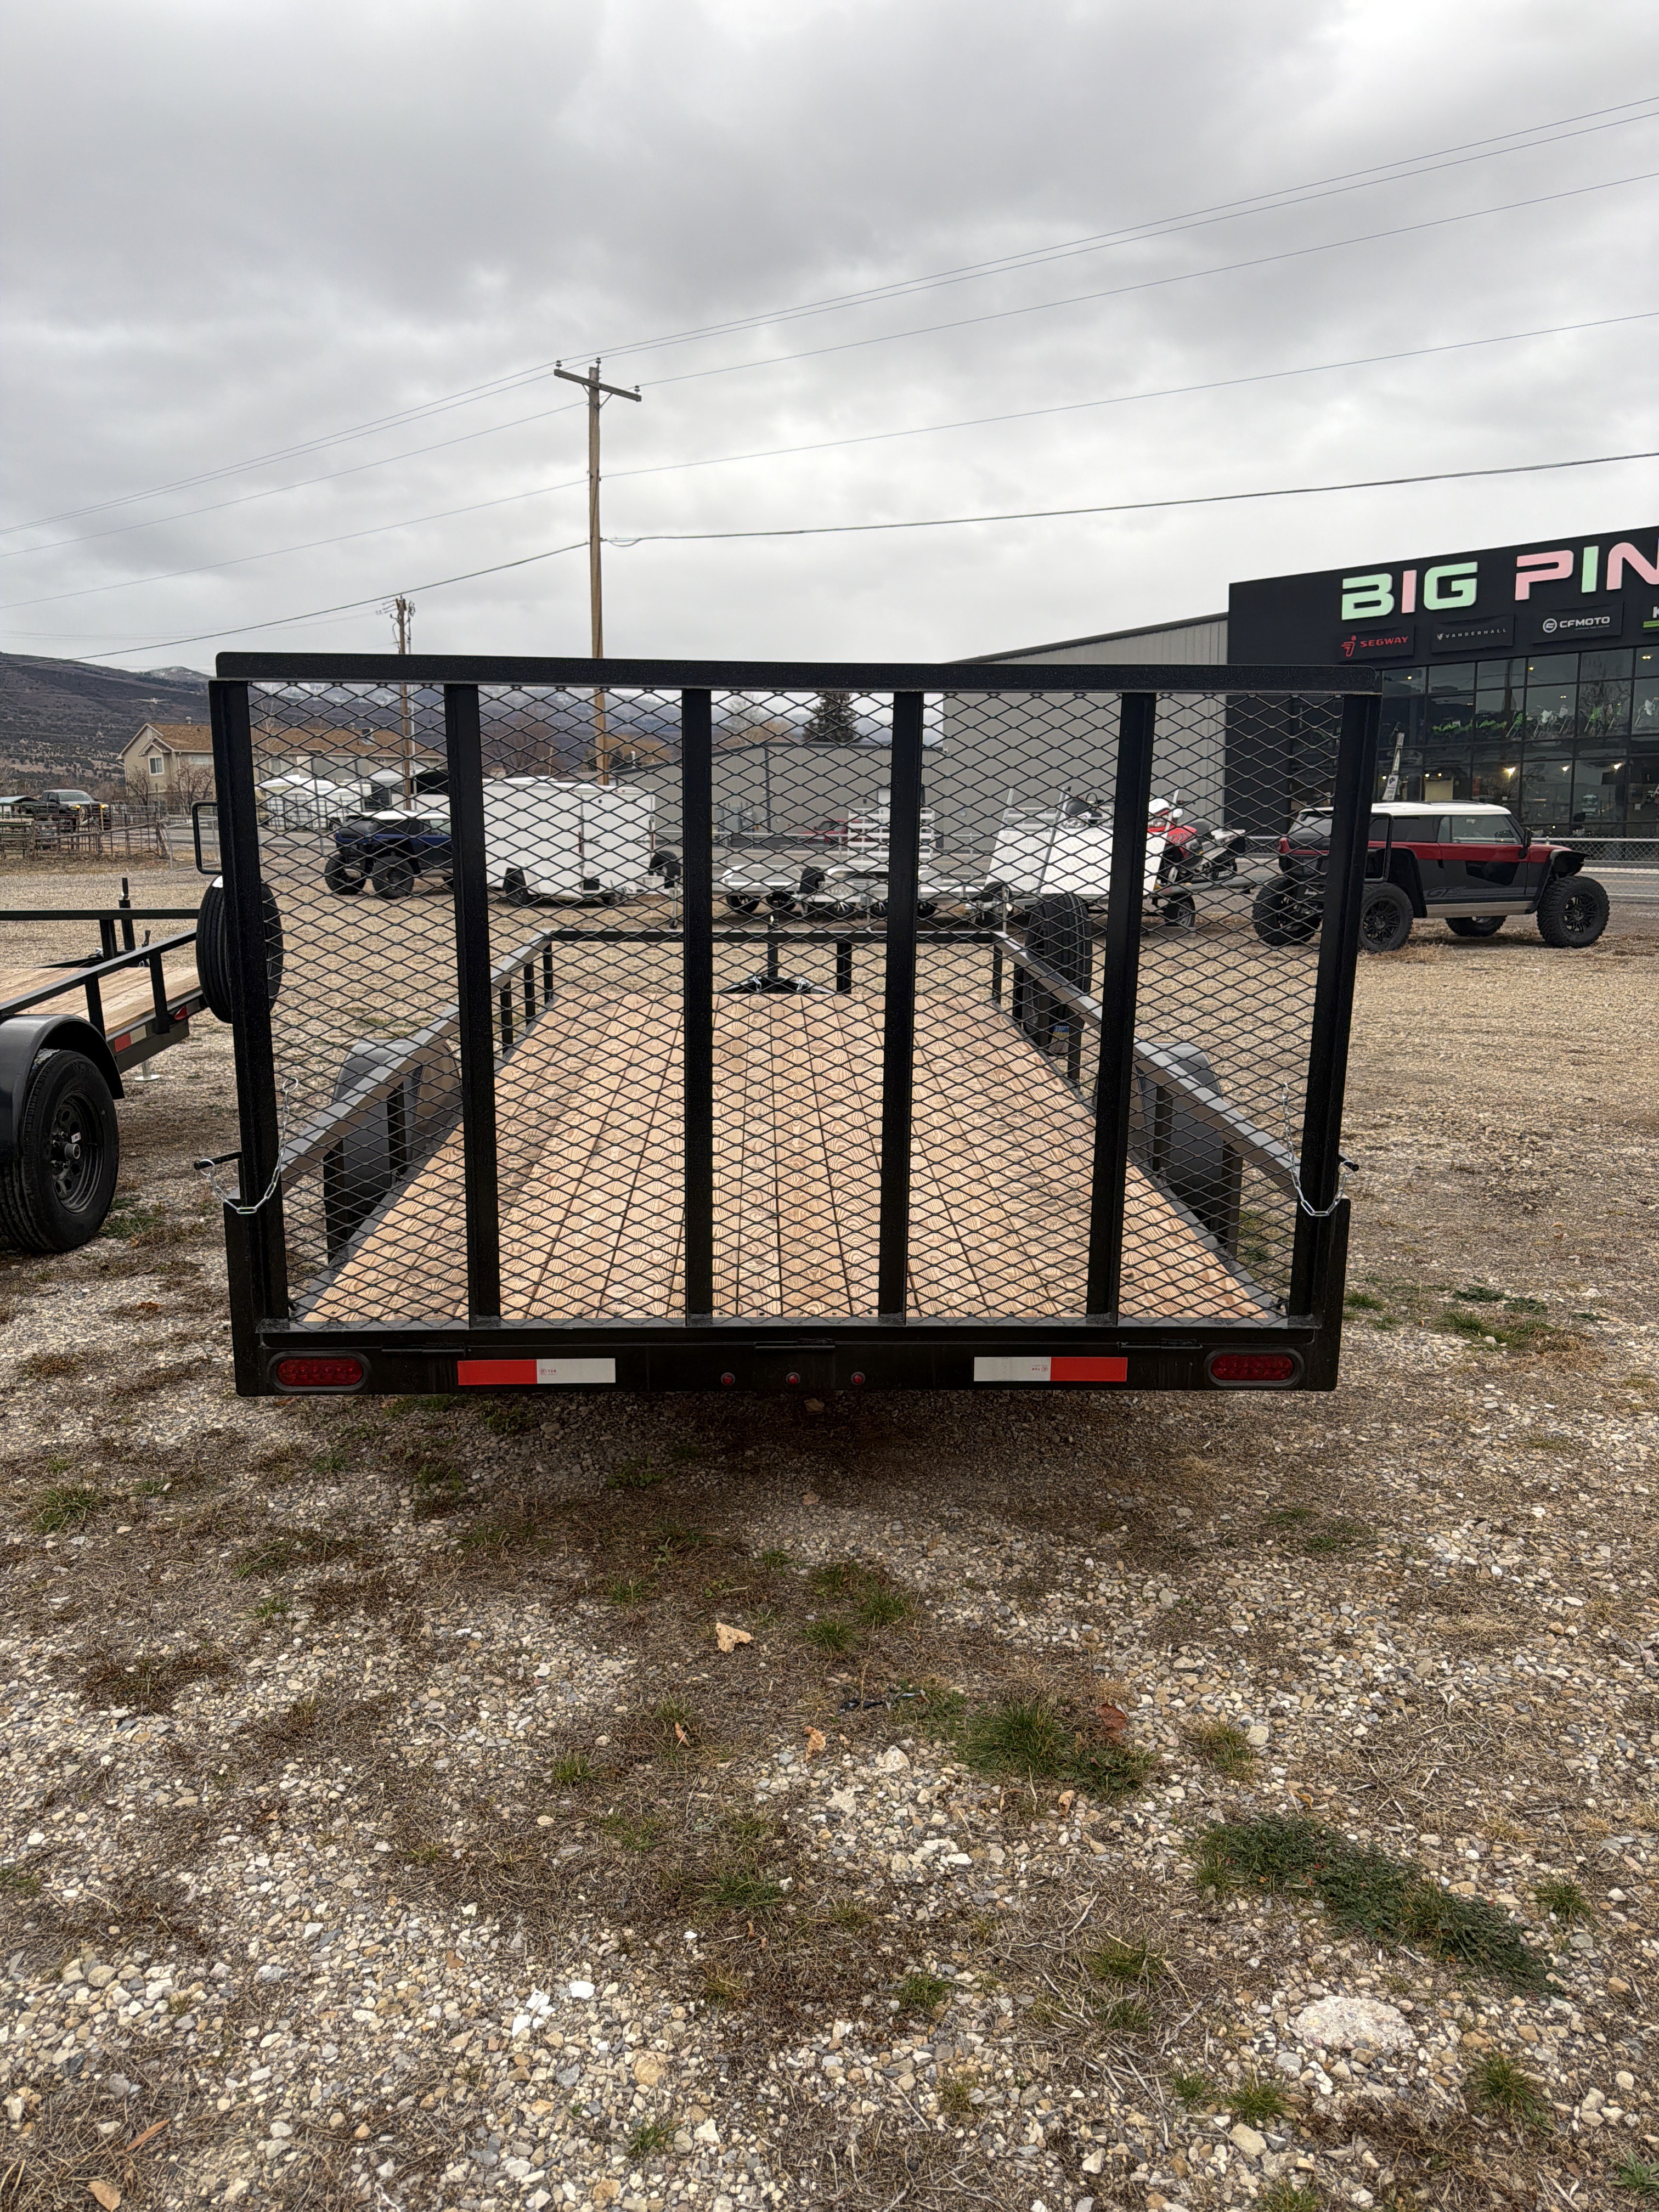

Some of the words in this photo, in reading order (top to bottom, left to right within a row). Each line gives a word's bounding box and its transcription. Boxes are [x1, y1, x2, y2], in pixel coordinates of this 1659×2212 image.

[1342, 561, 1478, 620] BIG
[1559, 616, 1611, 628] CFMOTO
[1360, 631, 1409, 647] SEGWAY
[1445, 628, 1507, 639] VANDERHALL
